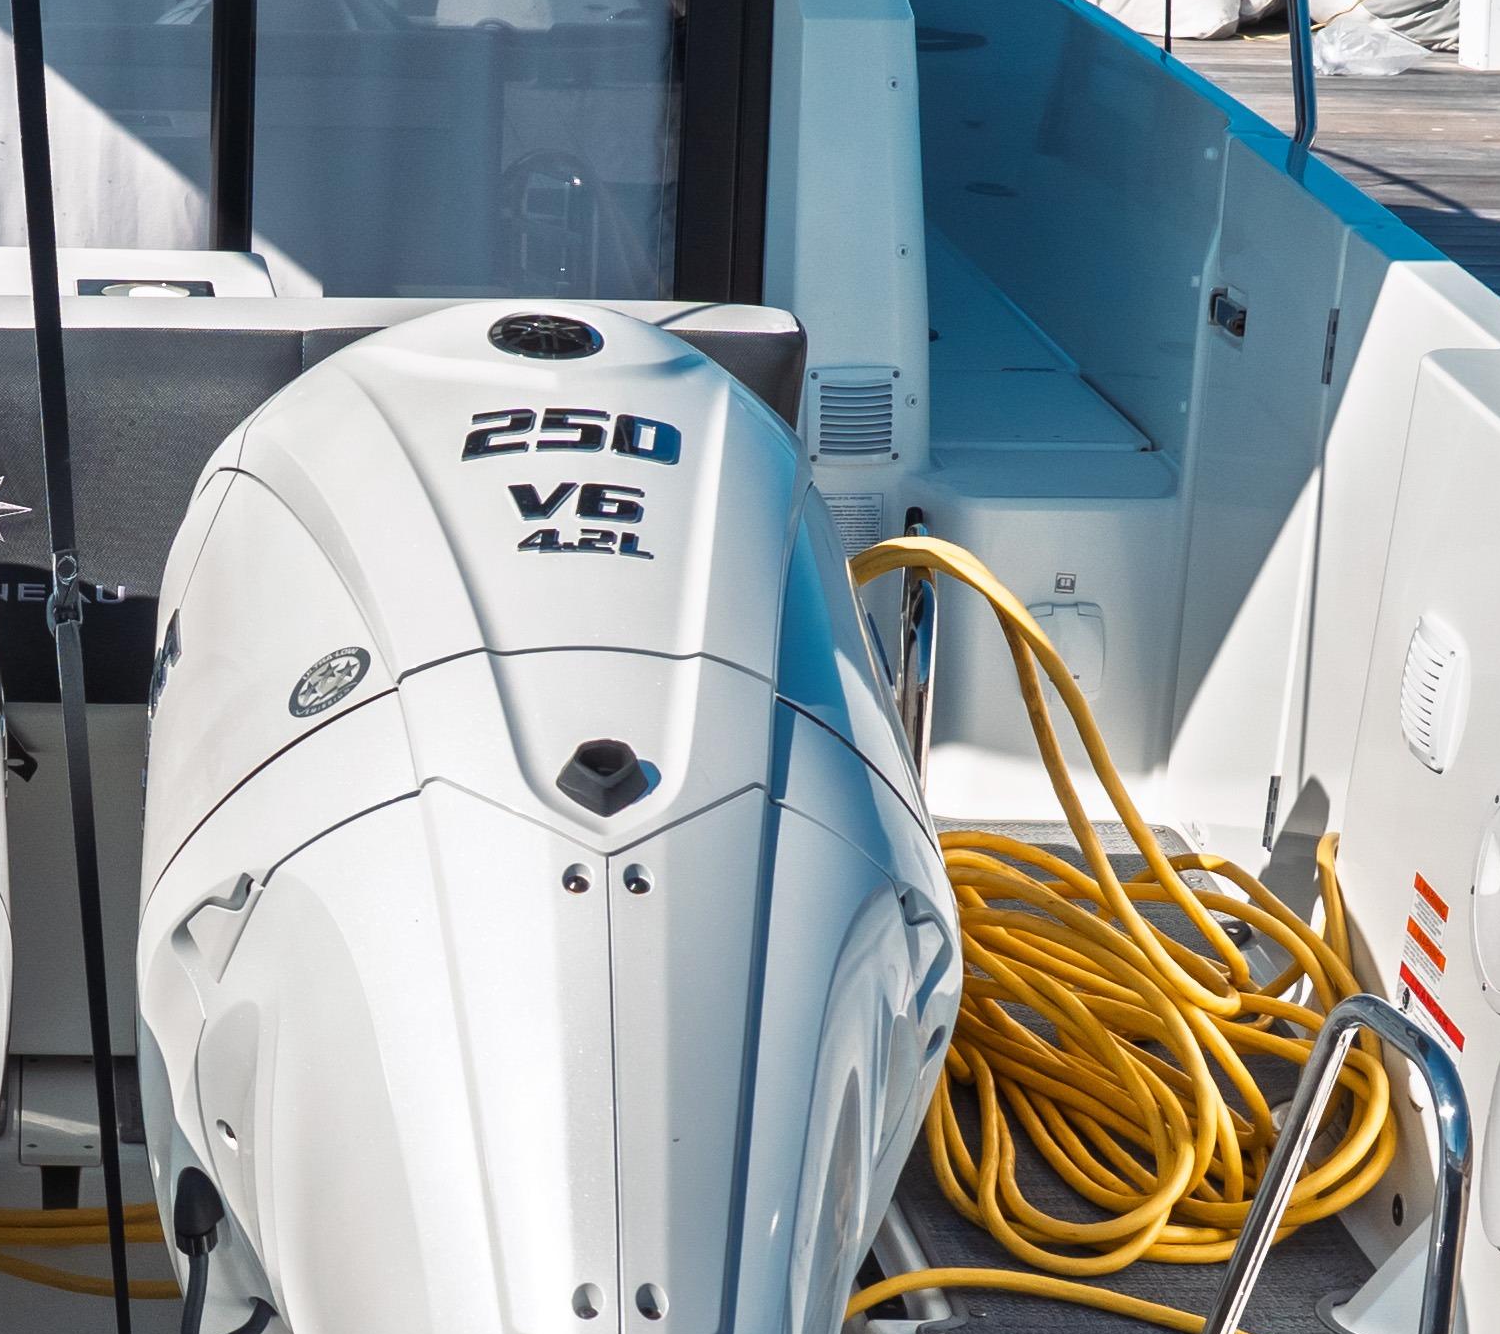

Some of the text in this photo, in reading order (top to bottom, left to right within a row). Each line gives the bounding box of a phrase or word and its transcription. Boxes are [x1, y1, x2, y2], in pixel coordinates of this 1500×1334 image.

[461, 408, 682, 466] 250
[508, 482, 645, 524] V6
[517, 528, 654, 560] 4.2L
